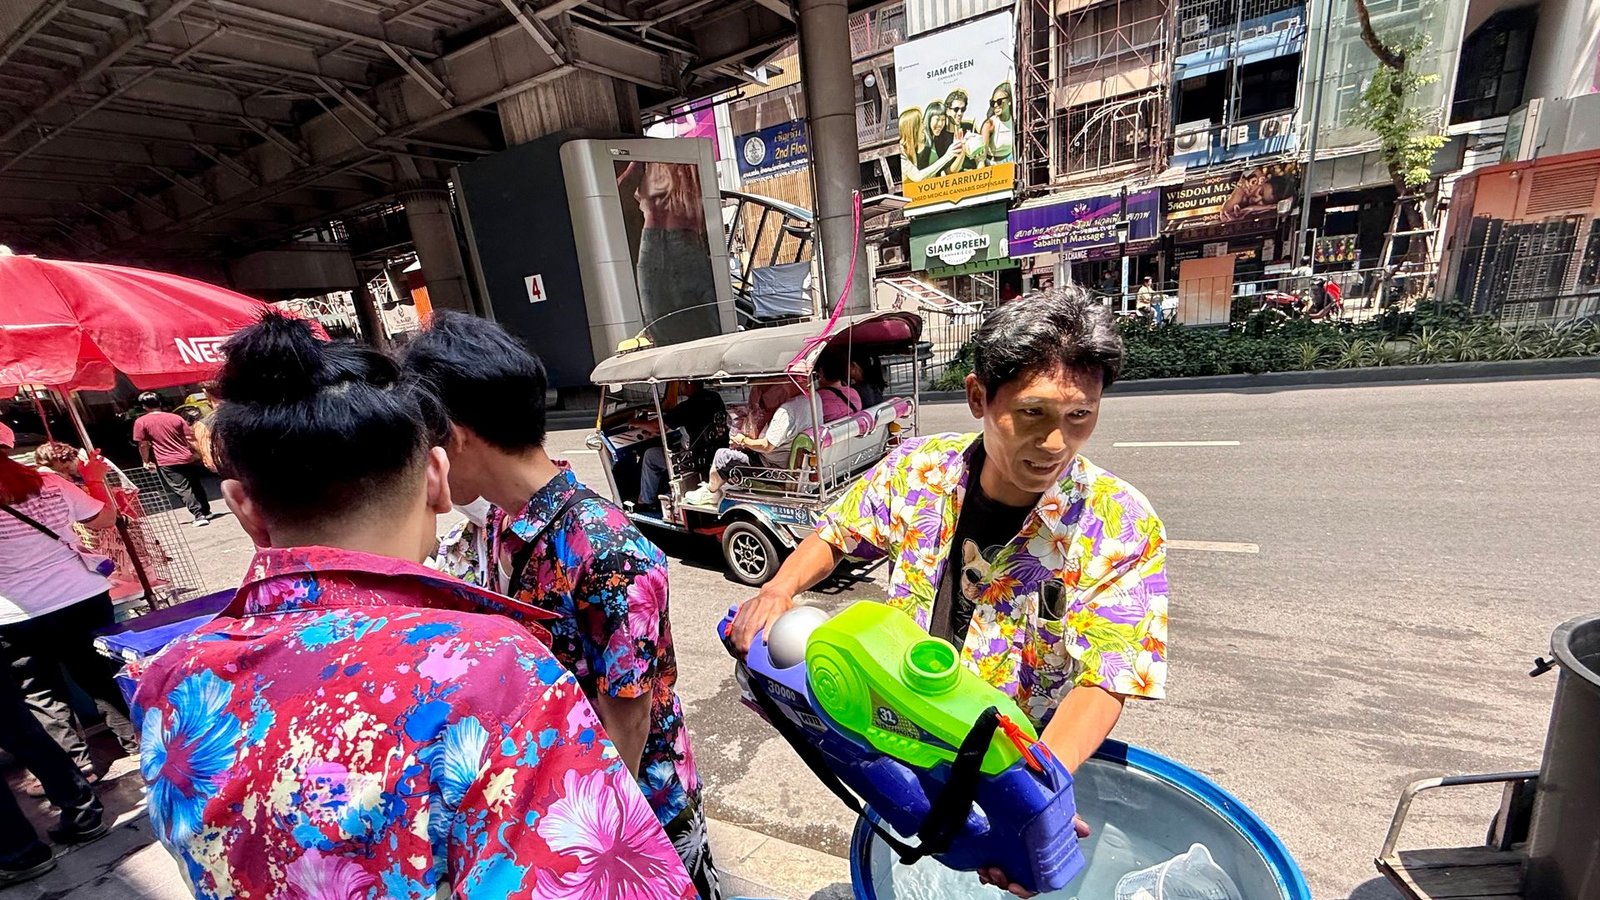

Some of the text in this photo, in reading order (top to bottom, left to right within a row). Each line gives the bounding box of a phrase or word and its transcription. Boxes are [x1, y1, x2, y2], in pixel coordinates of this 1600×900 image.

[926, 67, 947, 79] SIAM
[948, 59, 974, 73] GREEN
[775, 145, 789, 160] 2nd
[918, 170, 993, 193] YOU'VE ARRIVED!
[928, 191, 949, 199] MEDICAL
[949, 185, 976, 195] CANNABIS
[976, 179, 1009, 190] DISPENSARY
[1166, 185, 1212, 201] WISDOM
[928, 237, 987, 255] SIAM GREEN
[1069, 231, 1105, 244] Massage
[532, 277, 541, 300] 4
[767, 680, 796, 701] 30000
